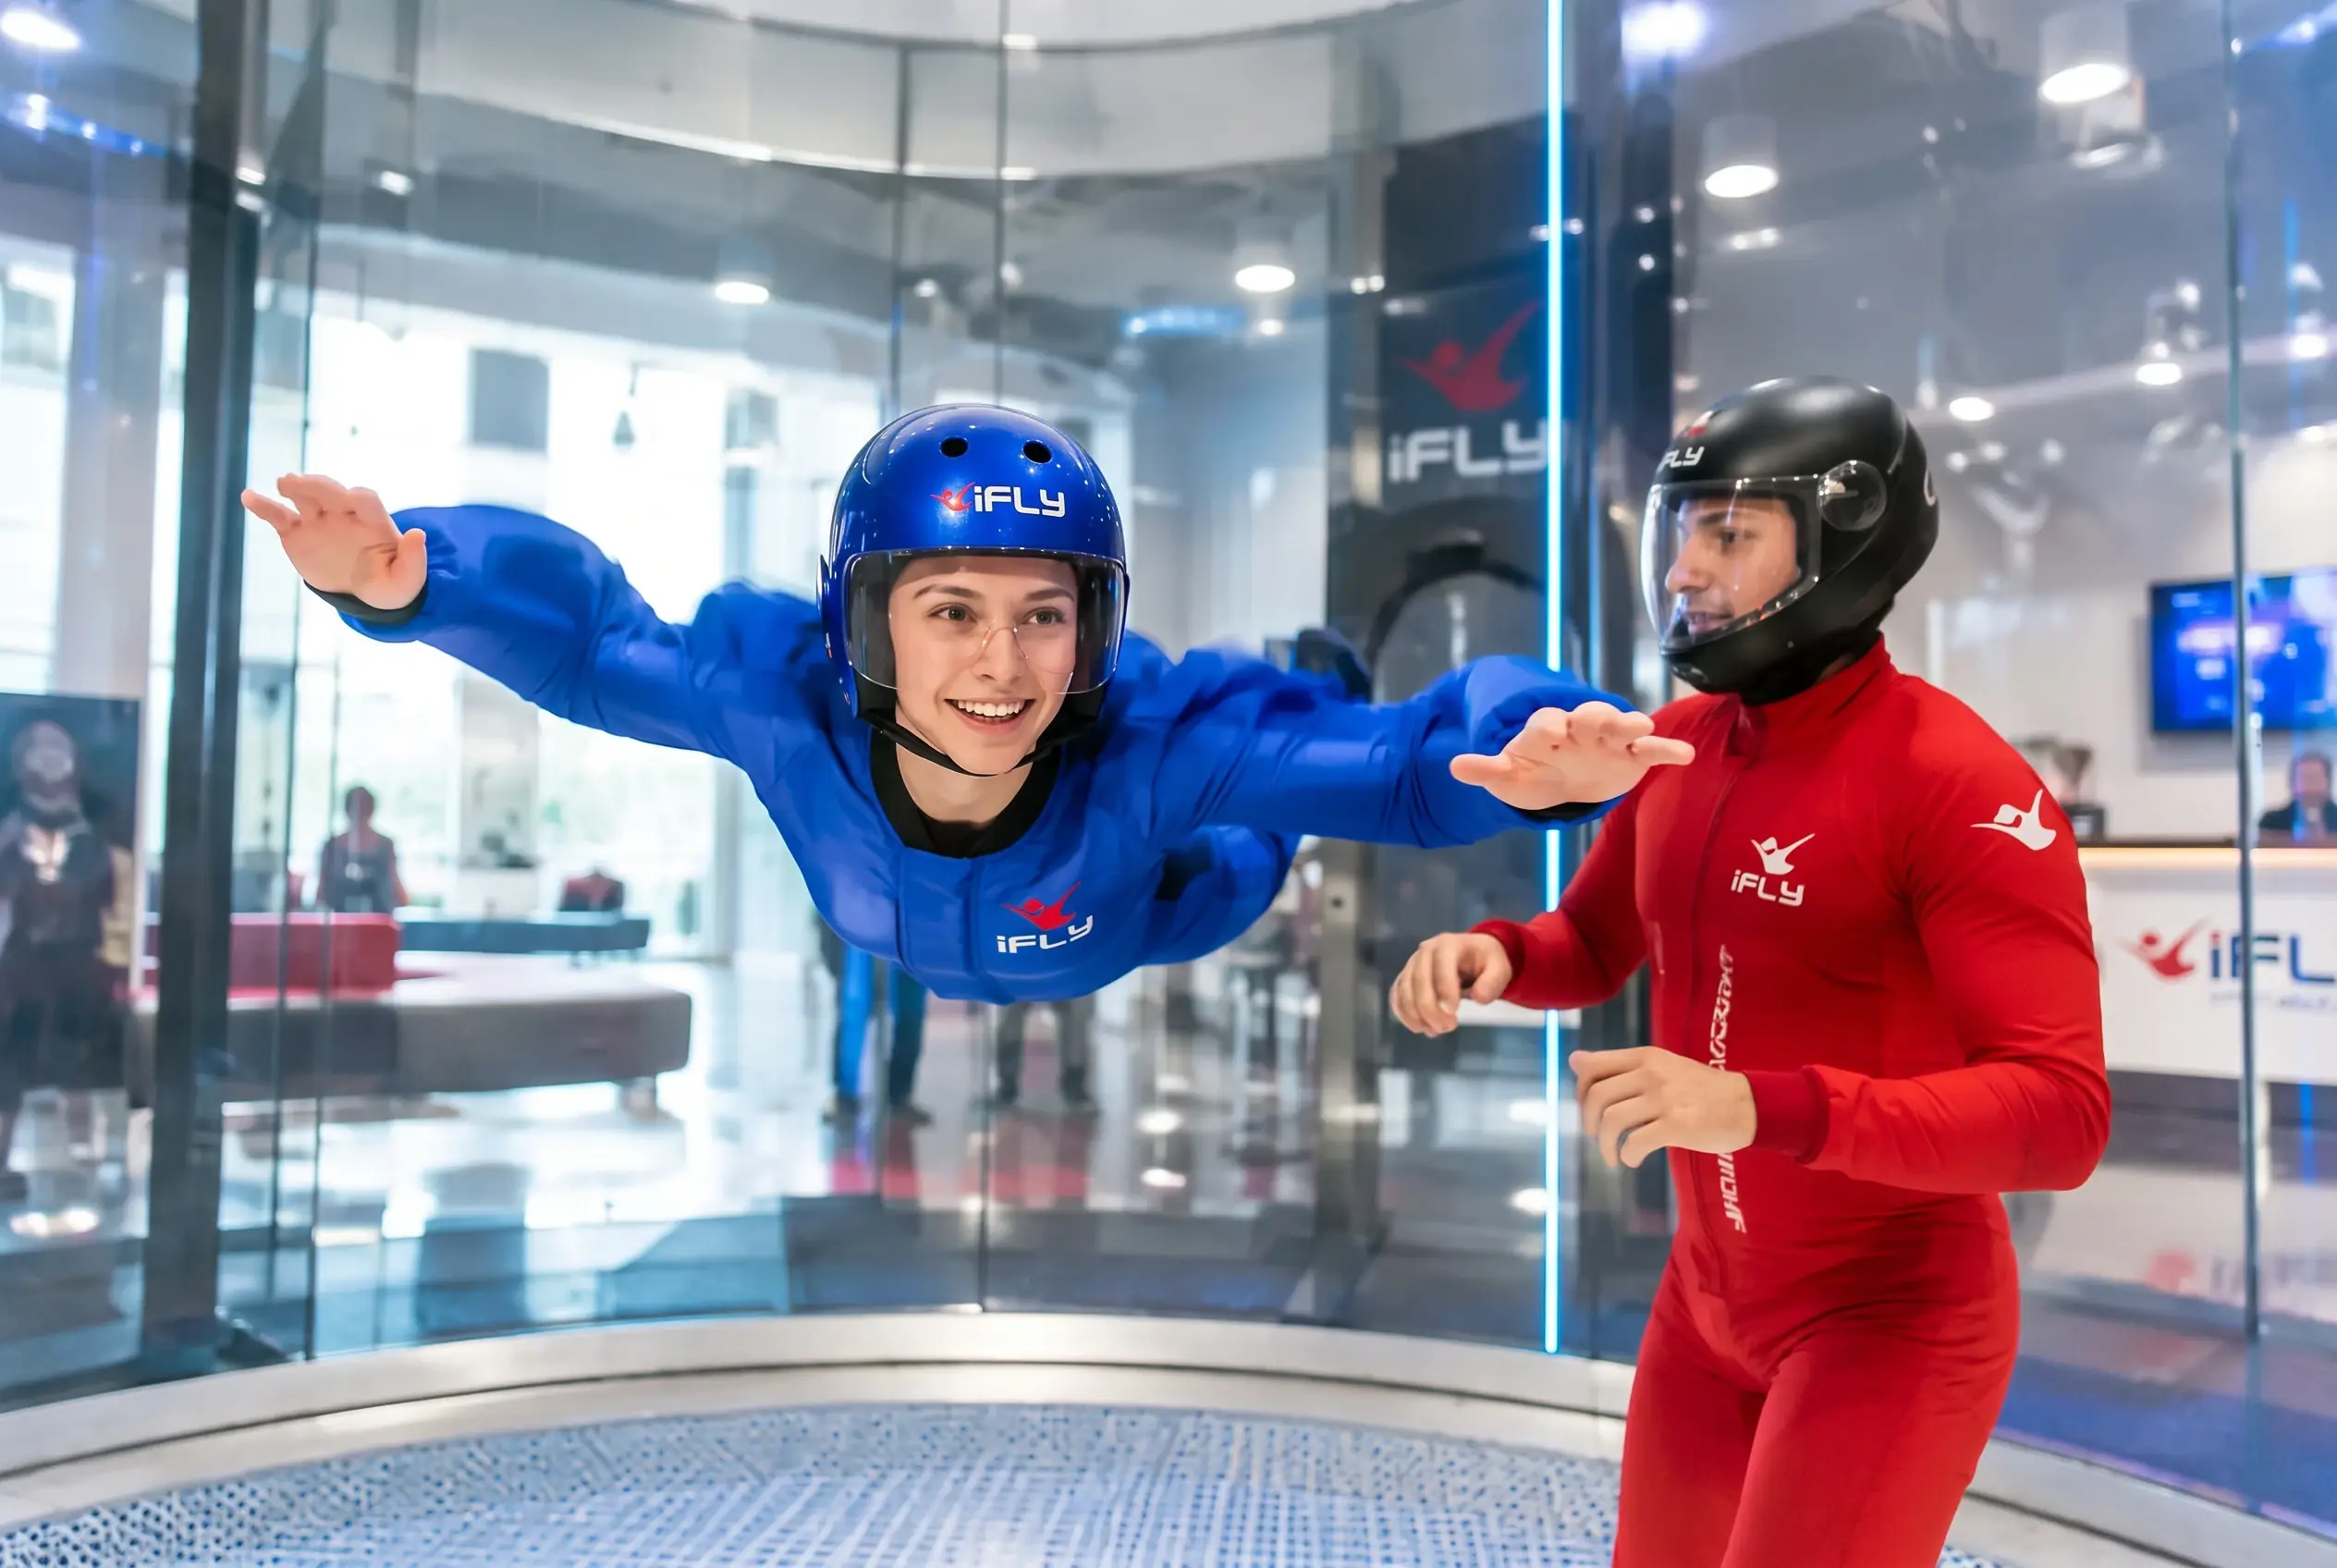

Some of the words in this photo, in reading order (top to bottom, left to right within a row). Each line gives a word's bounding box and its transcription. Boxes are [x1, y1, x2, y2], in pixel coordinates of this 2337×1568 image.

[1389, 420, 1549, 483] iFLY
[1656, 446, 1705, 472] FLY
[973, 485, 1066, 518] iFLY
[1731, 869, 1805, 907] iFLY
[997, 914, 1093, 953] iFLY
[2210, 932, 2336, 983] iFL
